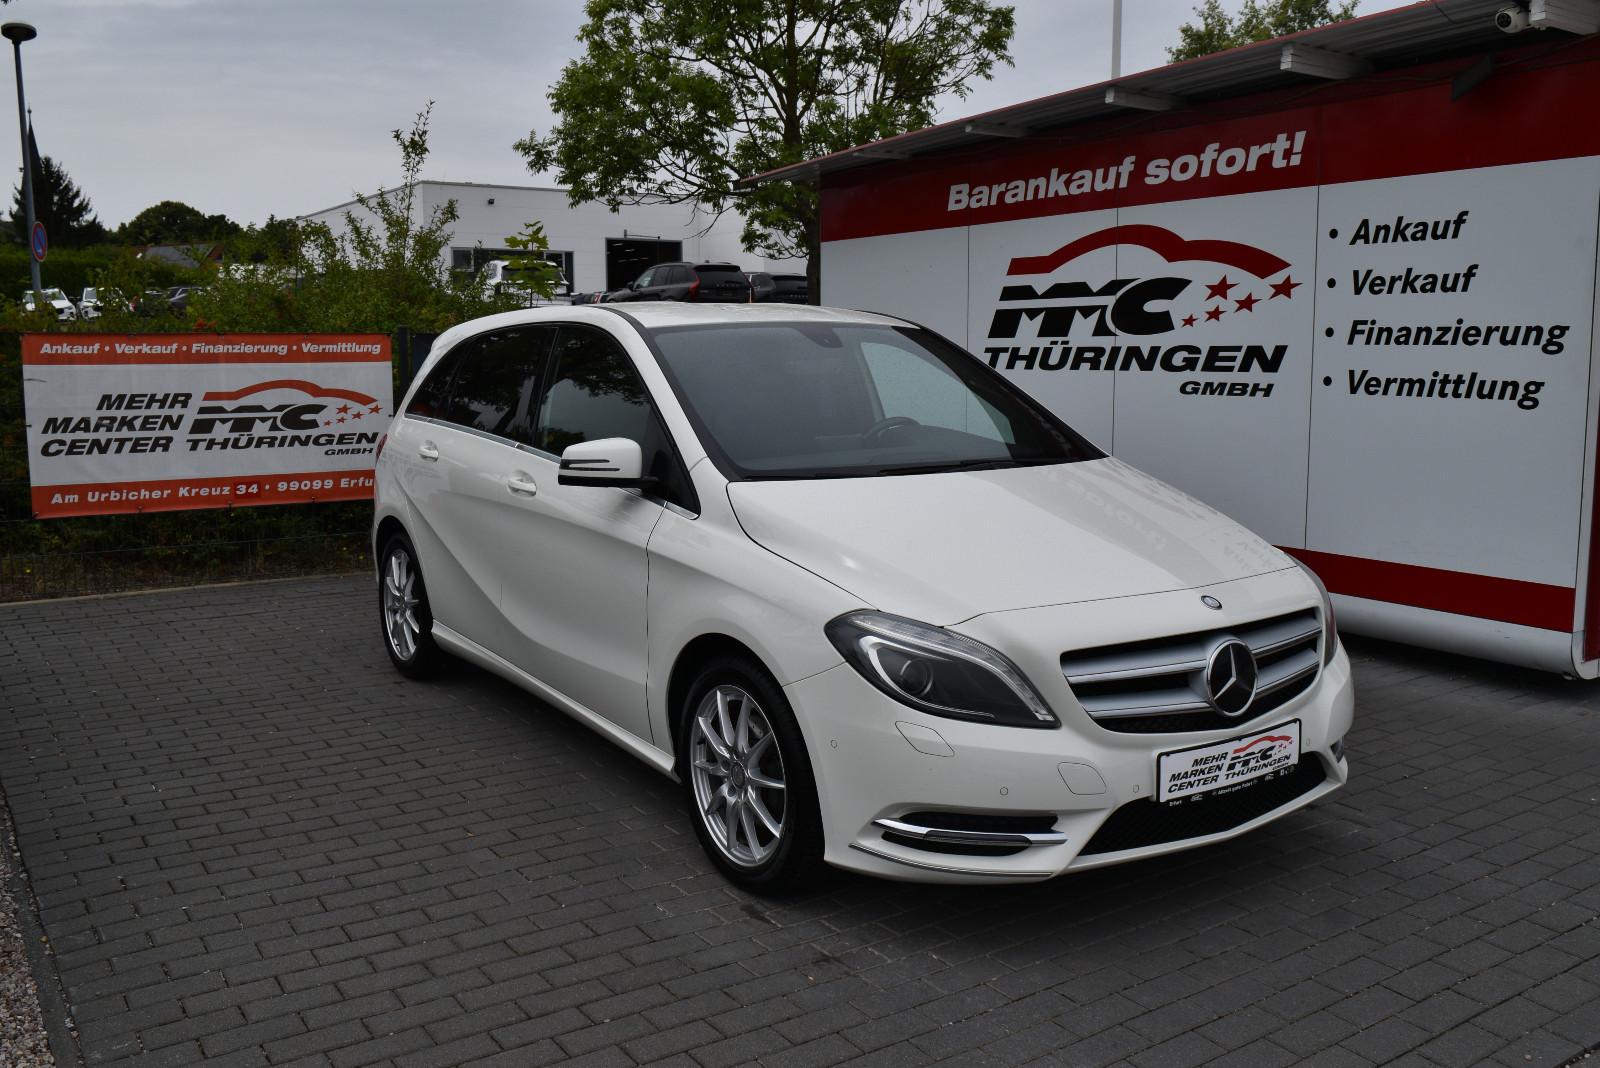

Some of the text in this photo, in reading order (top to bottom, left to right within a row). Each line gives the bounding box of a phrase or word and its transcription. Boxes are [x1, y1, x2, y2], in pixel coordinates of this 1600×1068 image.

[947, 131, 1307, 212] Barankauf sofort!
[1349, 211, 1469, 246] Ankauf
[1352, 264, 1479, 295] Verkauf
[987, 277, 1193, 338] MMC
[1347, 318, 1570, 355] Finanzierung
[40, 343, 381, 355] Ankauf Verkauf Finanzierung Vermittlung
[983, 340, 1288, 373] THÜRINGEN
[1179, 380, 1274, 398] GMBH
[1348, 369, 1545, 410] Vermittlung
[96, 392, 192, 411] MEHR
[41, 414, 185, 435] MARKEN
[188, 403, 329, 435] MMC
[40, 436, 174, 457] CENTER
[186, 432, 379, 452] THÜRINGEN
[324, 447, 374, 456] GMBH
[51, 476, 374, 505] Am Urbicher Kreuz 34 99099 Erfu
[1192, 751, 1228, 768] MEHR
[1226, 745, 1276, 772] MMC
[1168, 775, 1219, 793] CENTER
[1169, 763, 1224, 783] MARKEN
